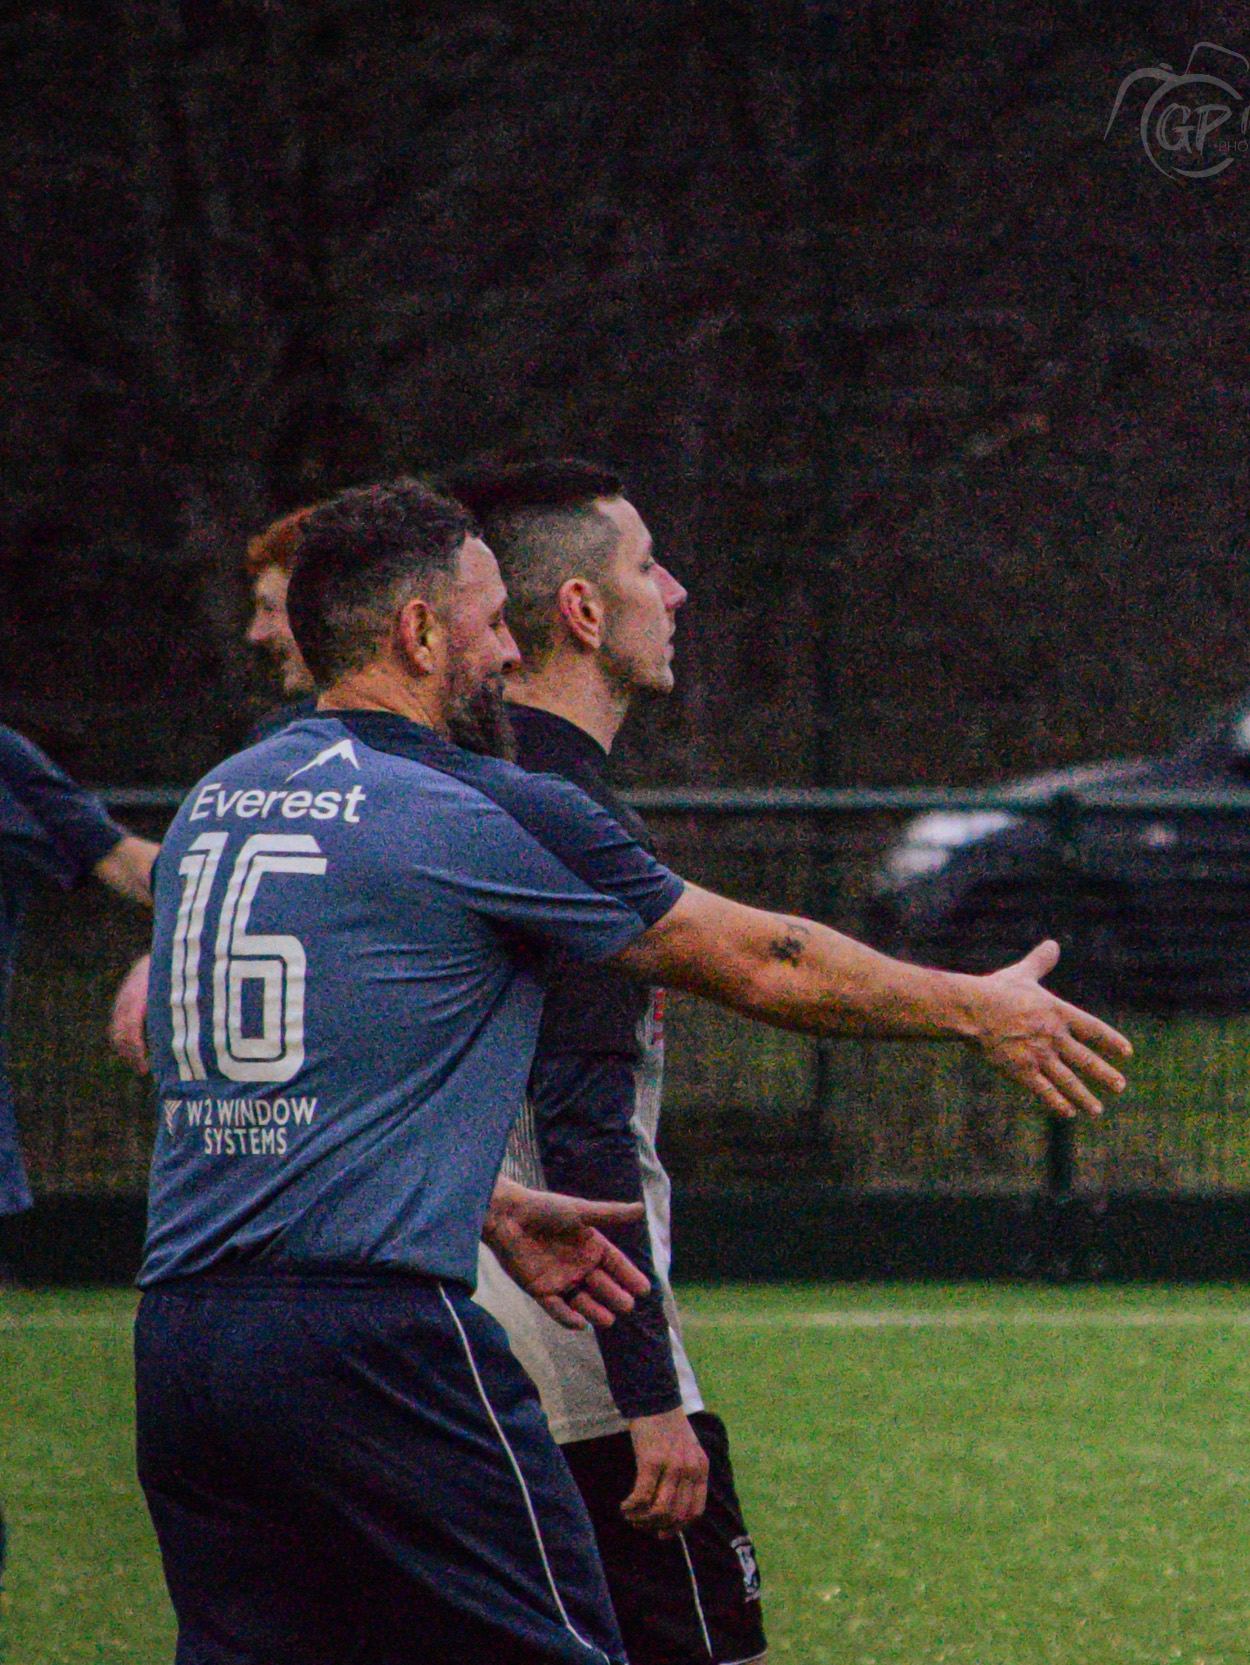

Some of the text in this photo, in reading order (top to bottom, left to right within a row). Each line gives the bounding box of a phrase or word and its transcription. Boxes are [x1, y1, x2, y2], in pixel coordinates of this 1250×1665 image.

[189, 783, 366, 823] Everest
[170, 831, 327, 1083] 16
[186, 1097, 318, 1126] W2 WINDOW
[203, 1126, 288, 1155] SYSTEMS
